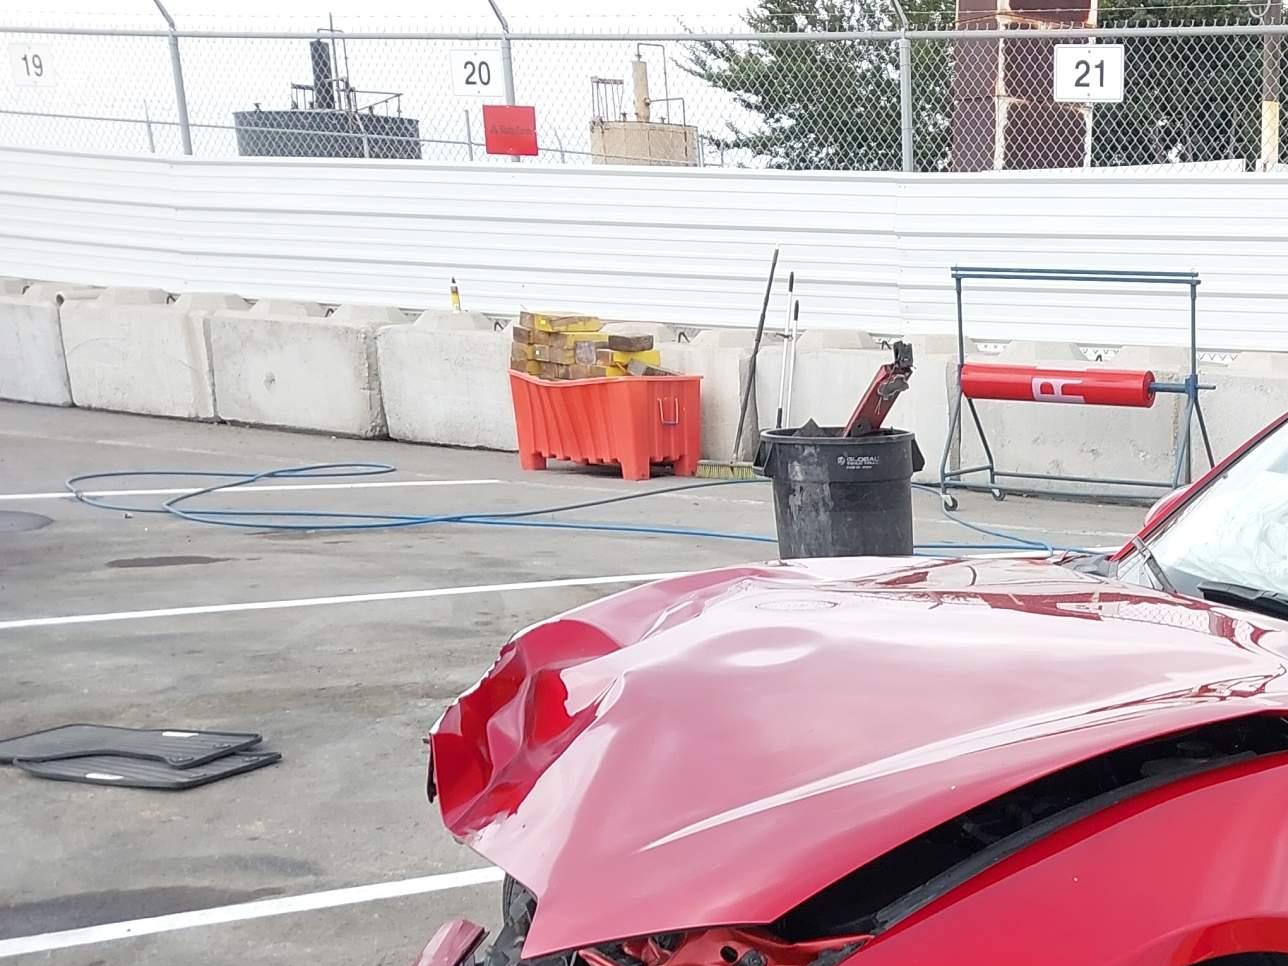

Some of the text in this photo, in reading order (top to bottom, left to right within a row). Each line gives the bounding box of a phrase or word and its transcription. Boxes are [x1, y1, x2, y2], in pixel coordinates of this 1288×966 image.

[21, 54, 43, 77] 19
[463, 61, 490, 85] 20
[1074, 59, 1104, 87] 21
